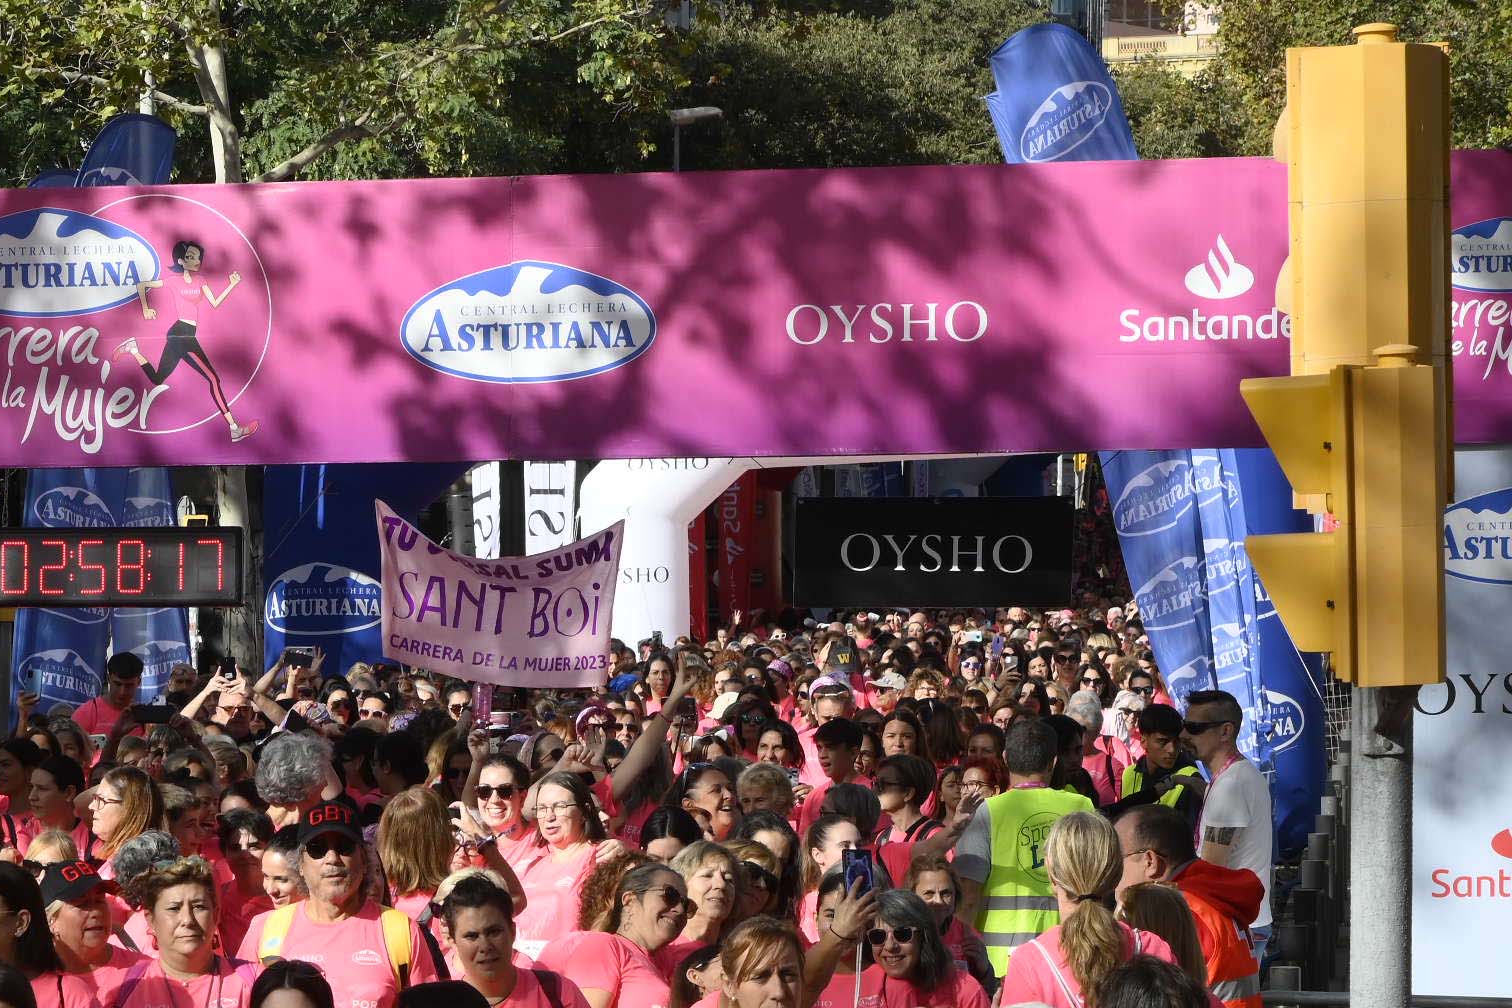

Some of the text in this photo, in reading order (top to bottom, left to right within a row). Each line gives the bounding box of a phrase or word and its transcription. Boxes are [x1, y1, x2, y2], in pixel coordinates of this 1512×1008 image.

[63, 245, 136, 256] LECHERA
[460, 302, 629, 317] CENTRAL LECHERA
[785, 300, 989, 345] OYSHO
[420, 308, 637, 352] ASTURIANA
[1, 368, 26, 409] la
[21, 361, 170, 454] Mujer
[382, 516, 418, 552] TU
[840, 533, 1033, 574] OYSHO
[0, 540, 224, 594] 02:58:17
[269, 590, 382, 619] ASTURIANA
[392, 571, 518, 636] SANT
[389, 633, 607, 672] CARRERA DE LA MUJER 2023
[309, 805, 353, 826] GBY
